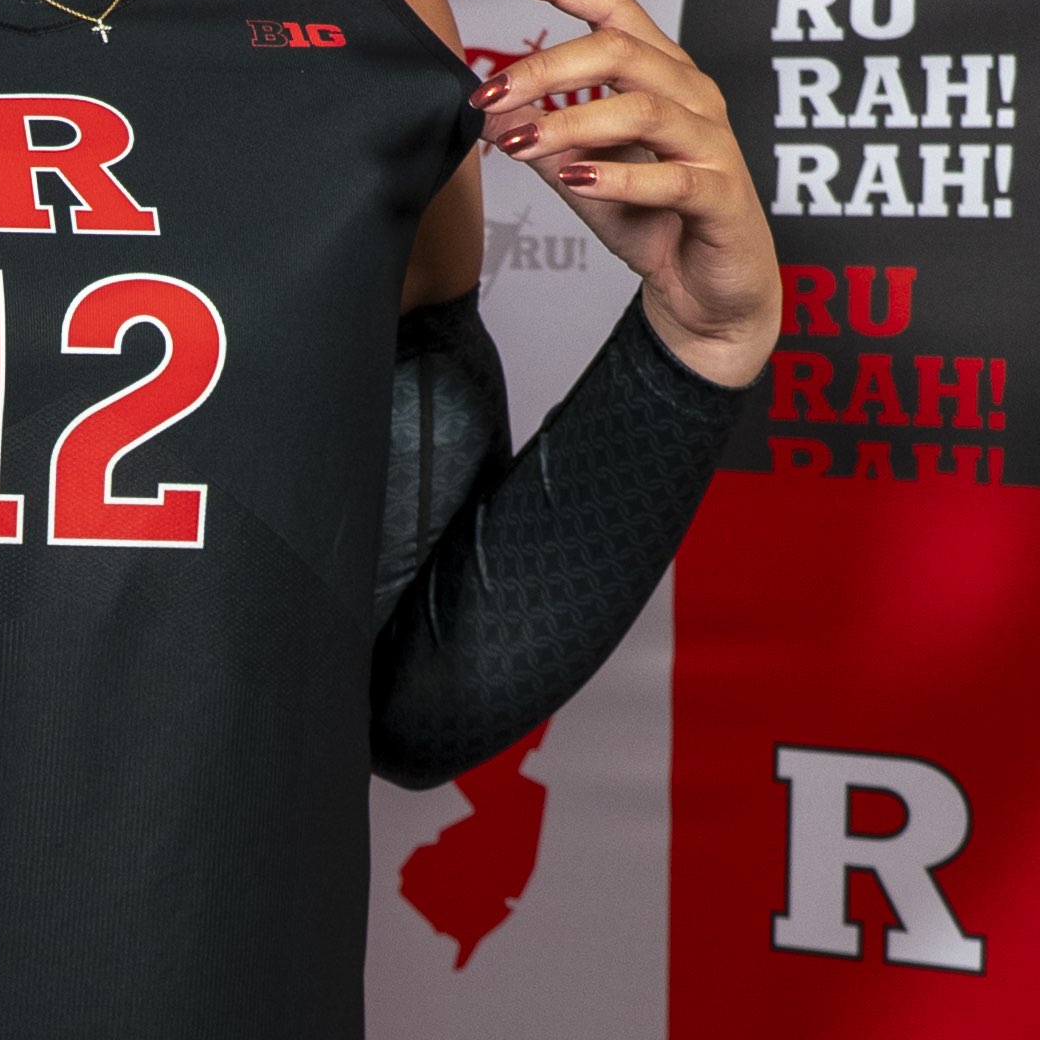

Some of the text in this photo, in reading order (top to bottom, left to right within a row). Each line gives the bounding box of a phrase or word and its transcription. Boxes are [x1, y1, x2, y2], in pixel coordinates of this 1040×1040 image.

[771, 54, 1017, 128] RAH!
[771, 143, 1013, 218] RAH!
[510, 236, 587, 272] RU!
[779, 264, 918, 337] RU
[768, 351, 1007, 430] RAH!
[771, 742, 987, 977] R
